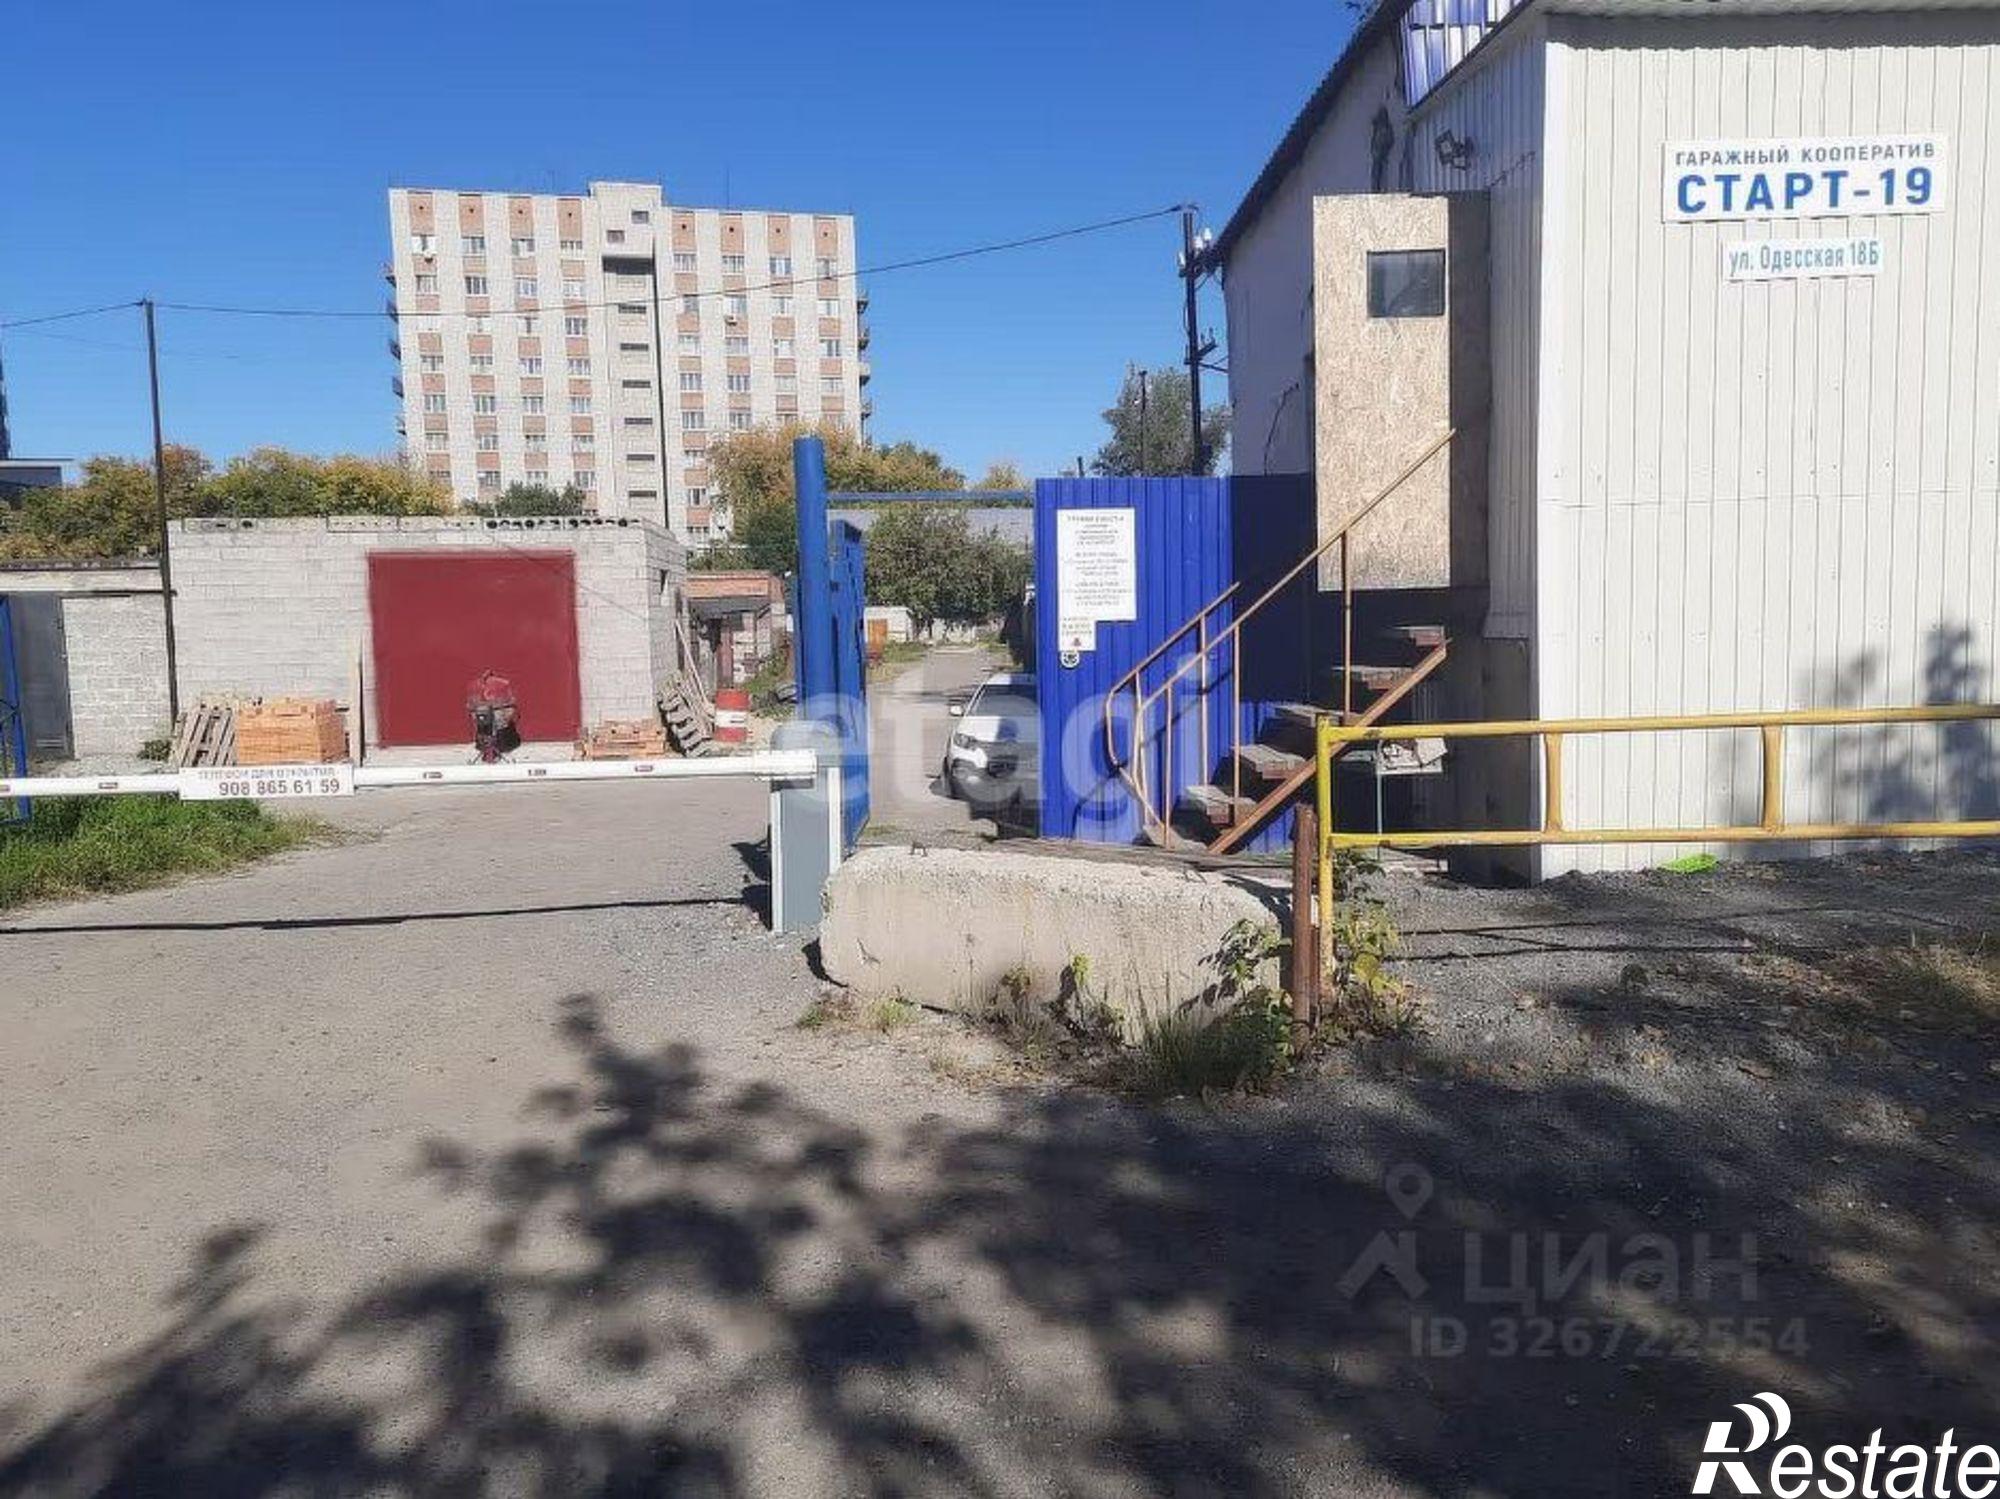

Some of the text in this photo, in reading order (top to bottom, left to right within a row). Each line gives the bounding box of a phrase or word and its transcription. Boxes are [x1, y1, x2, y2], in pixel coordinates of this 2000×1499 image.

[1675, 142, 1935, 166] ГАРАЖНЫЙ КООПЕРАТИВ
[1677, 166, 1933, 214] СТАРТ-19
[1728, 240, 1879, 277] ул. Одесская 18Б
[219, 778, 340, 796] 908 865 61 59
